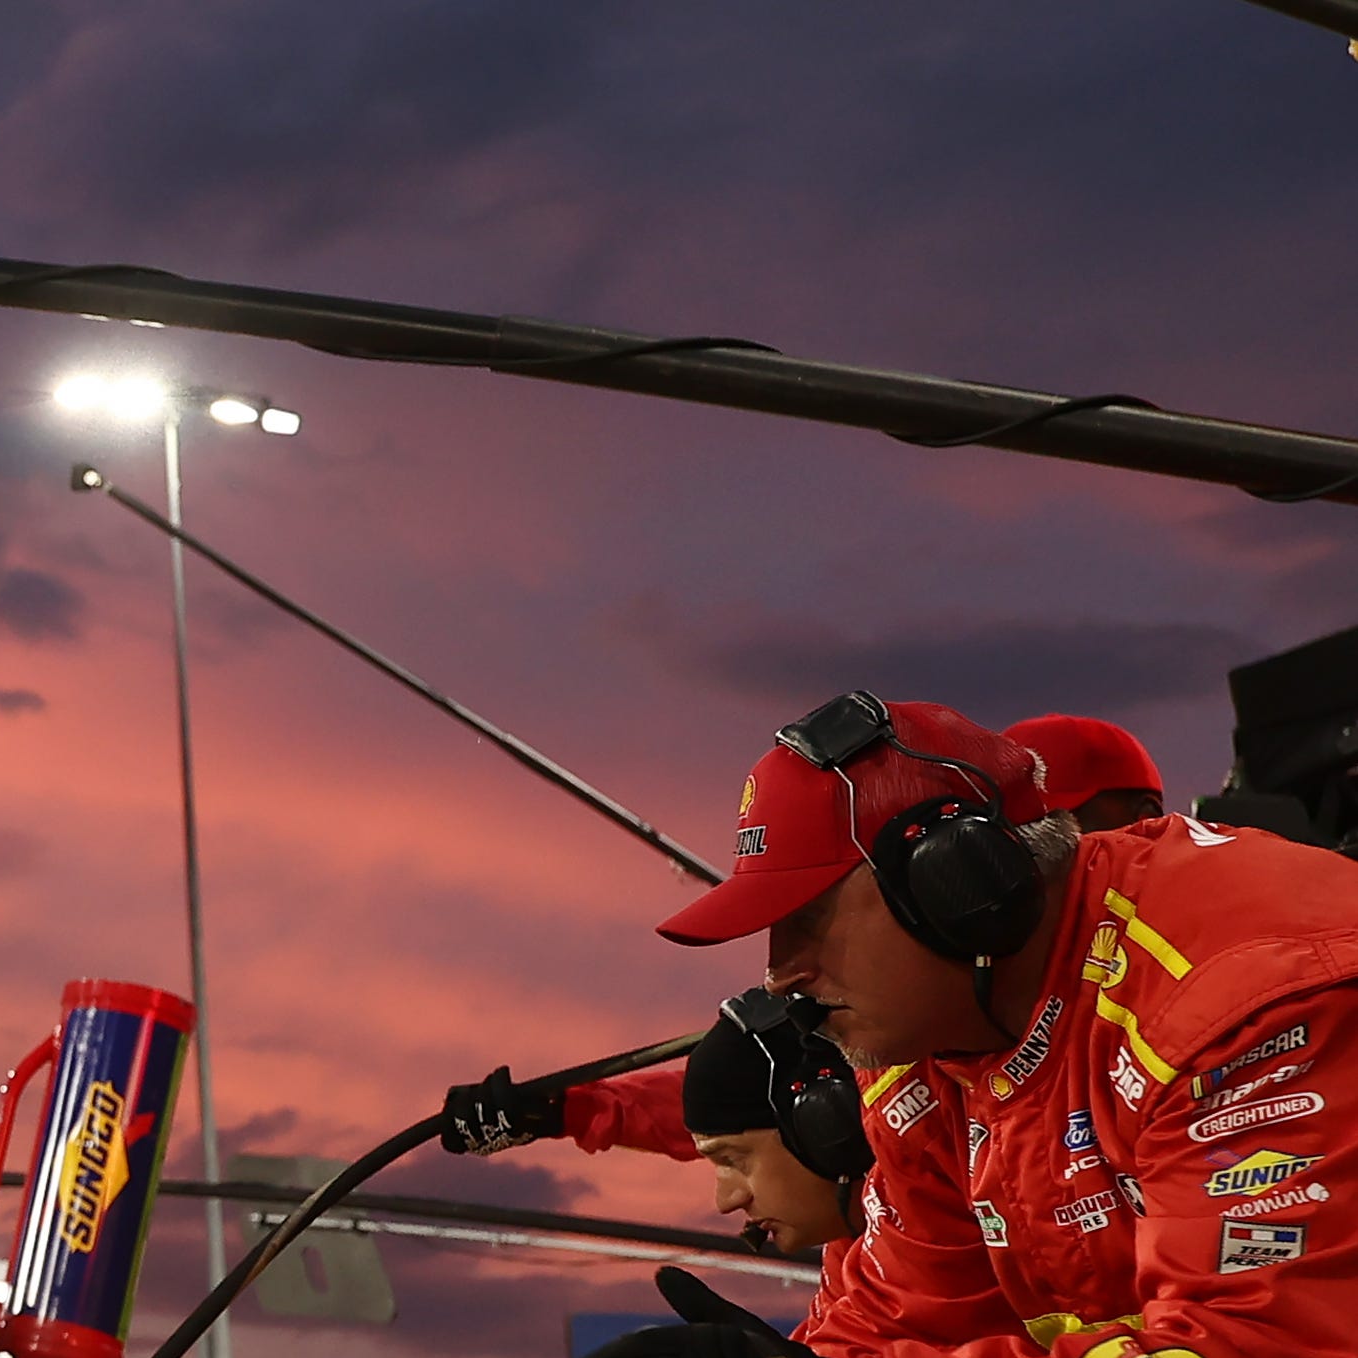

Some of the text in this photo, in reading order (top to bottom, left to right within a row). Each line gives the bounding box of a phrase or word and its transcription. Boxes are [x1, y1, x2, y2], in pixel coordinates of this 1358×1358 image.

[1221, 1025, 1306, 1079] NASCAR
[885, 1084, 930, 1130] OMP
[1201, 1097, 1312, 1137] FREIGHTLINER
[64, 1086, 120, 1246] SUNOCO
[1214, 1160, 1307, 1194] SUNOC
[1239, 1245, 1292, 1258] TEAM
